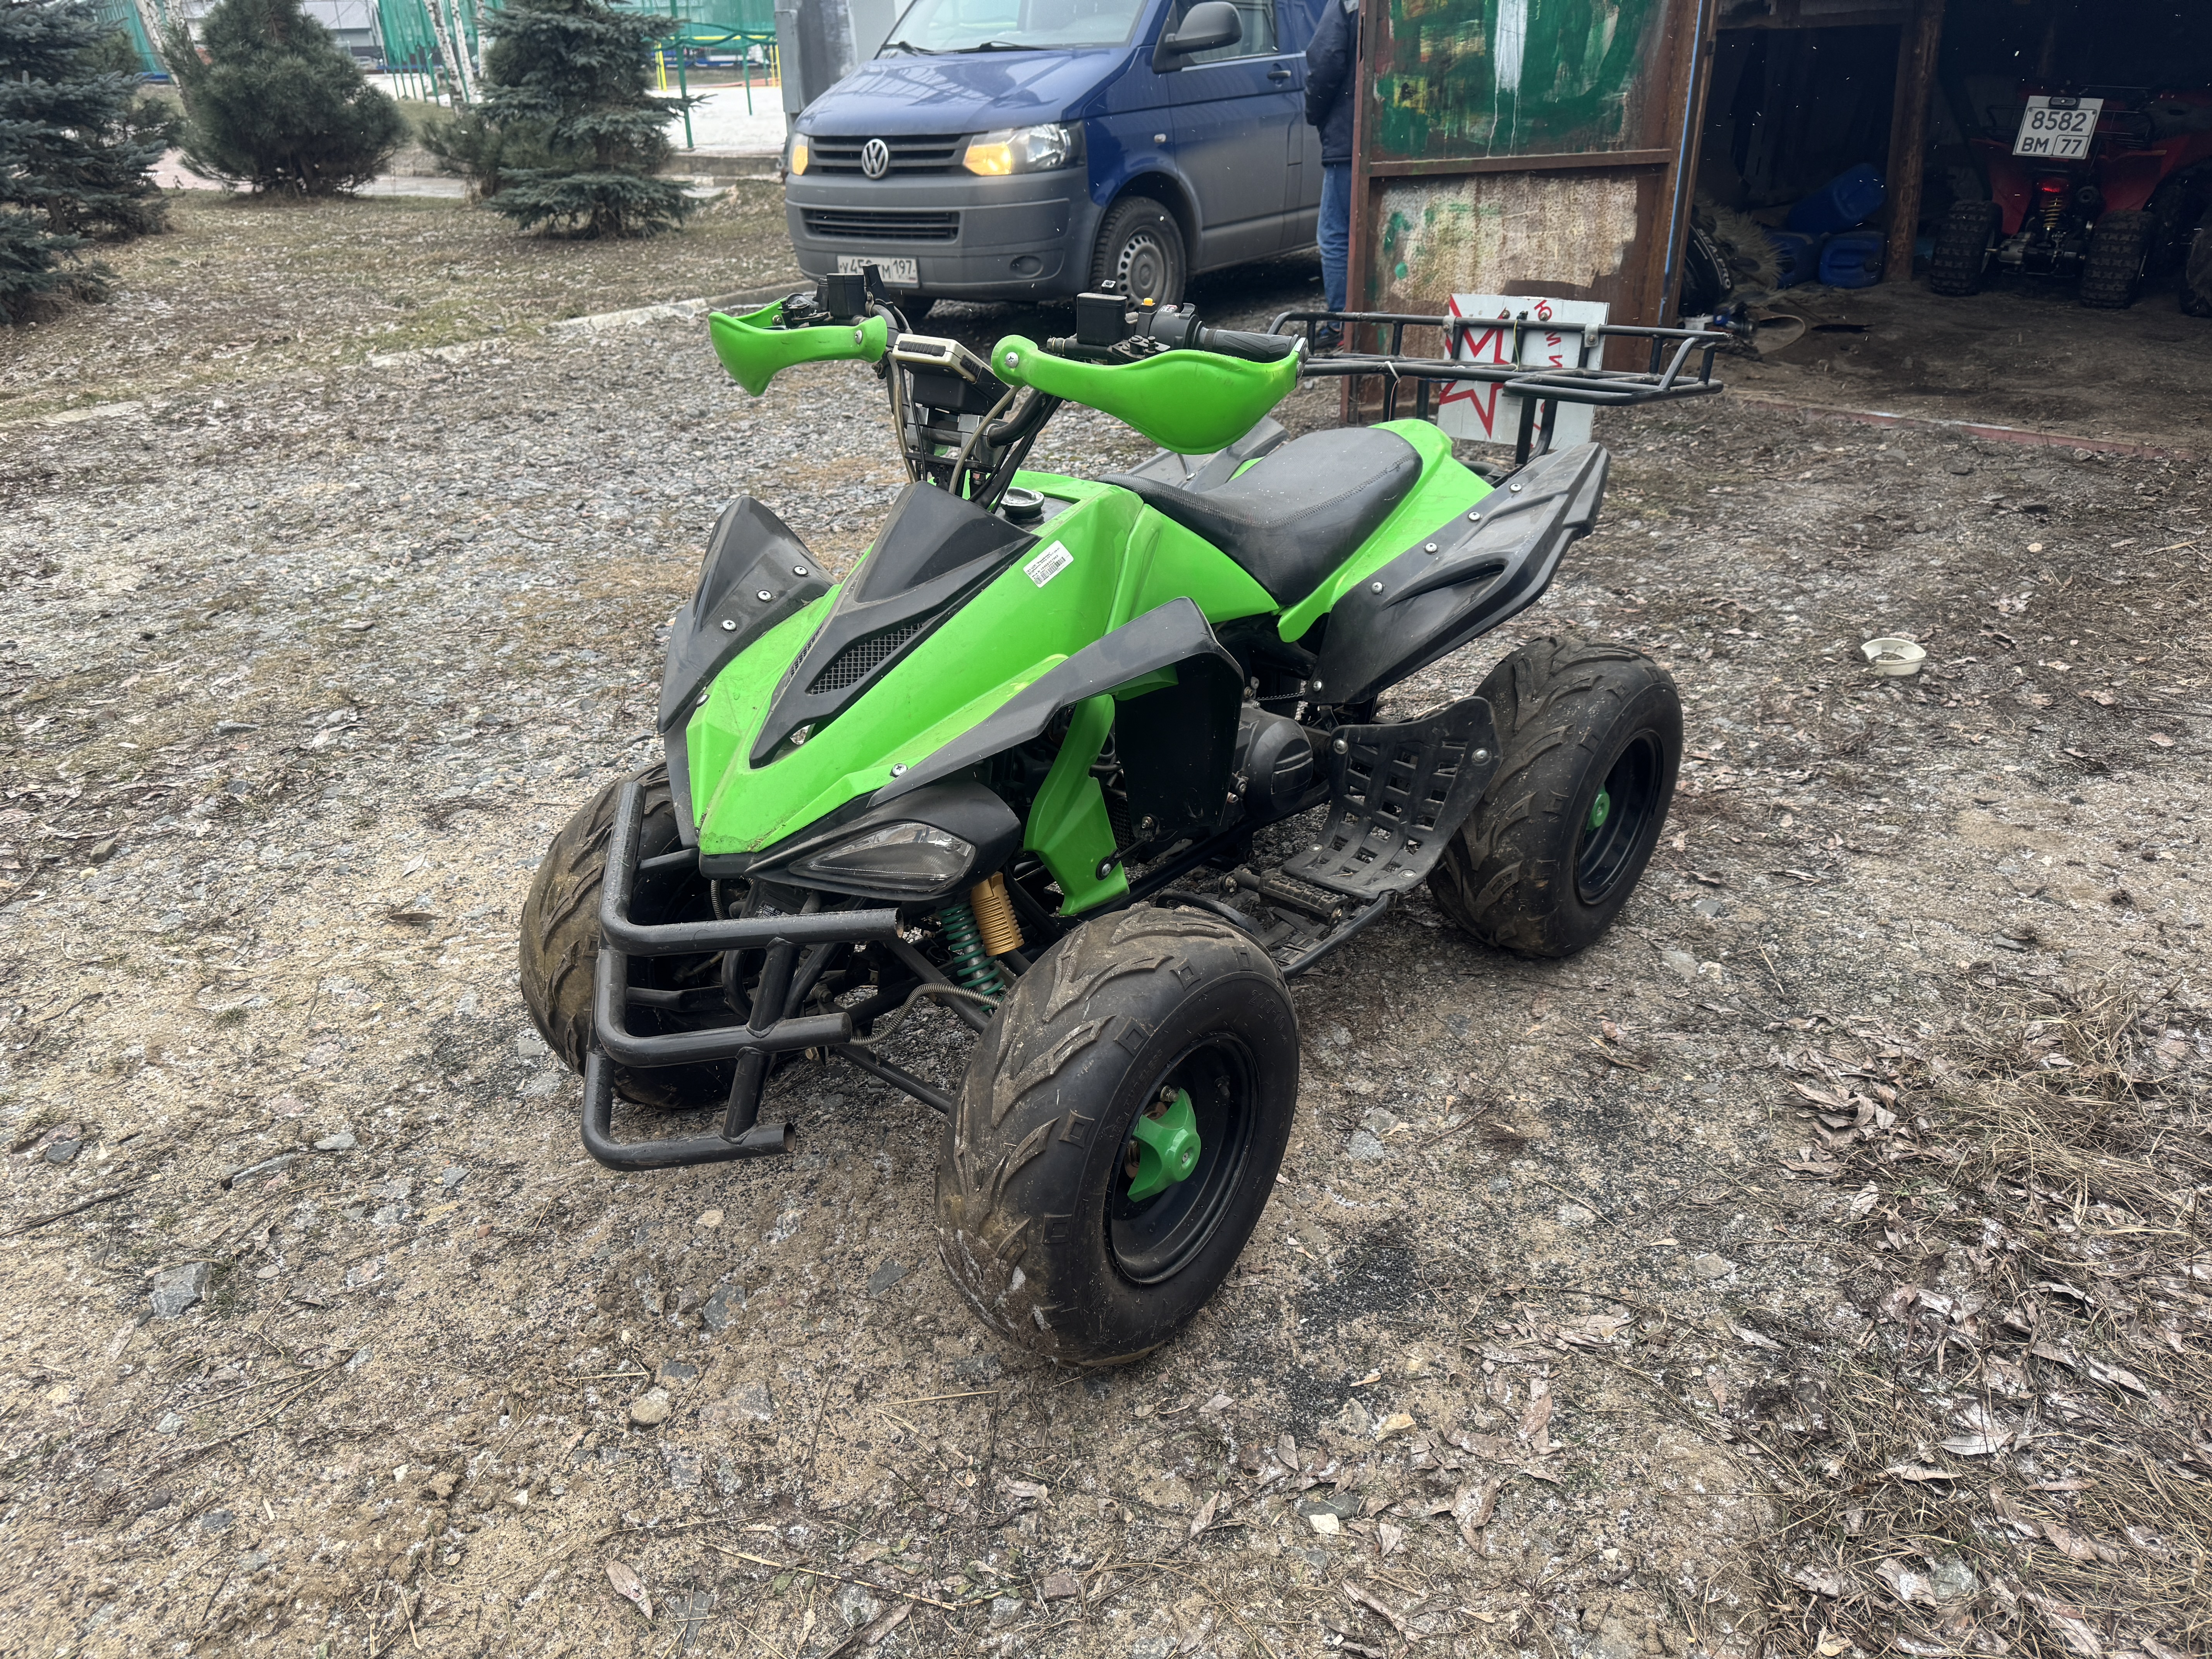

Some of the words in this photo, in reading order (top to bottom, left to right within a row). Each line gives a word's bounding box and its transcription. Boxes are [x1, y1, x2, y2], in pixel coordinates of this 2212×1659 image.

[2032, 111, 2087, 132] 8582
[2021, 137, 2050, 153] ВМ
[2060, 139, 2083, 155] 77
[842, 259, 891, 278] У45М
[893, 259, 912, 275] 197
[1697, 228, 1731, 290] SEA-PRO
